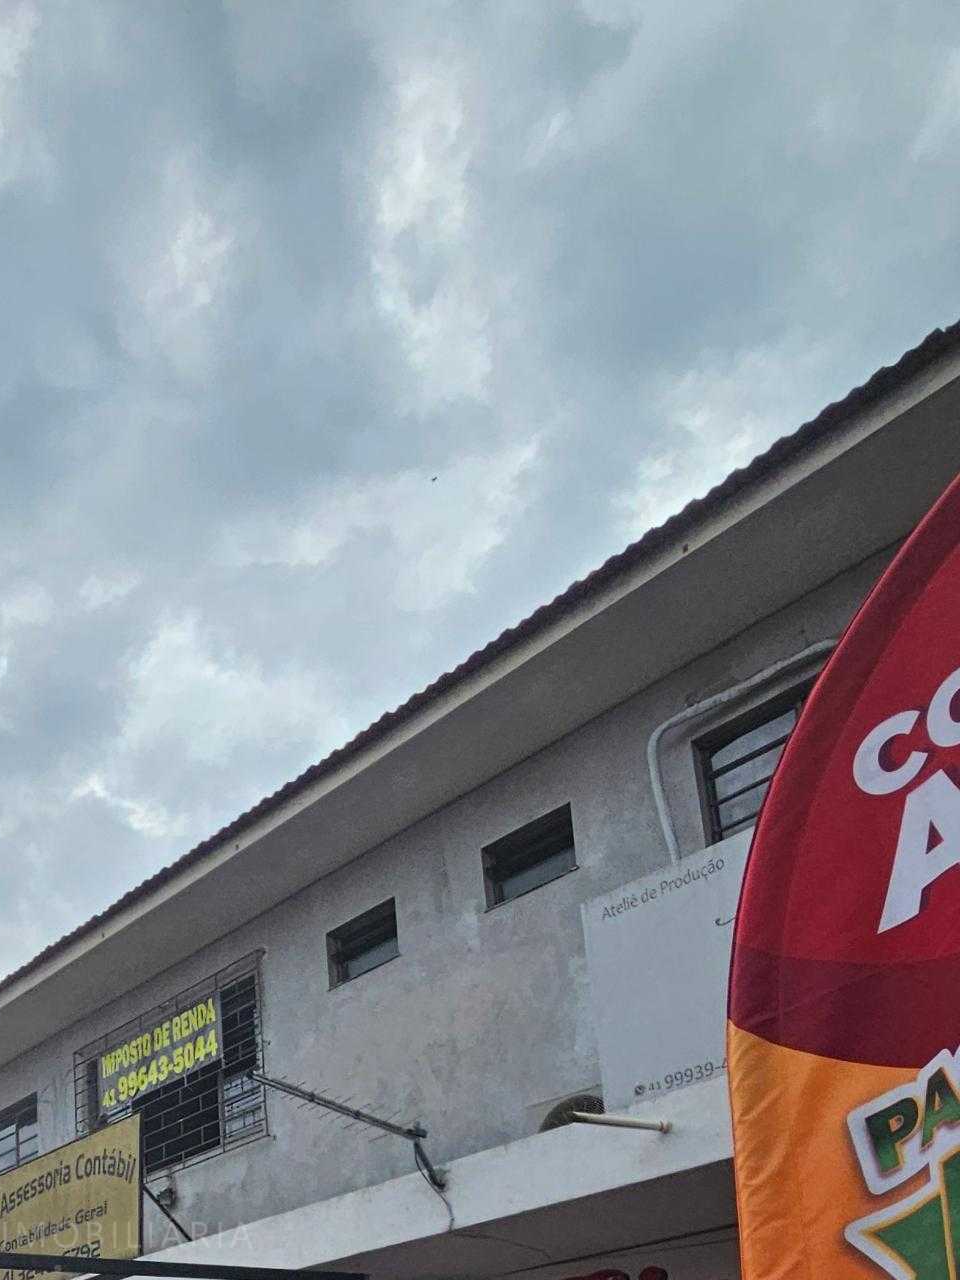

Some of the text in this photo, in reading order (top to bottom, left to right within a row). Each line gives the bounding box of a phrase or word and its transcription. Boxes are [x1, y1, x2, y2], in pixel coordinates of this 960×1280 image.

[641, 887, 657, 904] de
[660, 857, 725, 896] Produção
[102, 998, 216, 1078] IMPOSTO DE RENDA
[118, 1029, 218, 1101] 99643-5044
[0, 1161, 71, 1220] Assessoria
[75, 1148, 137, 1184] Contábil
[75, 1200, 108, 1225] Geral
